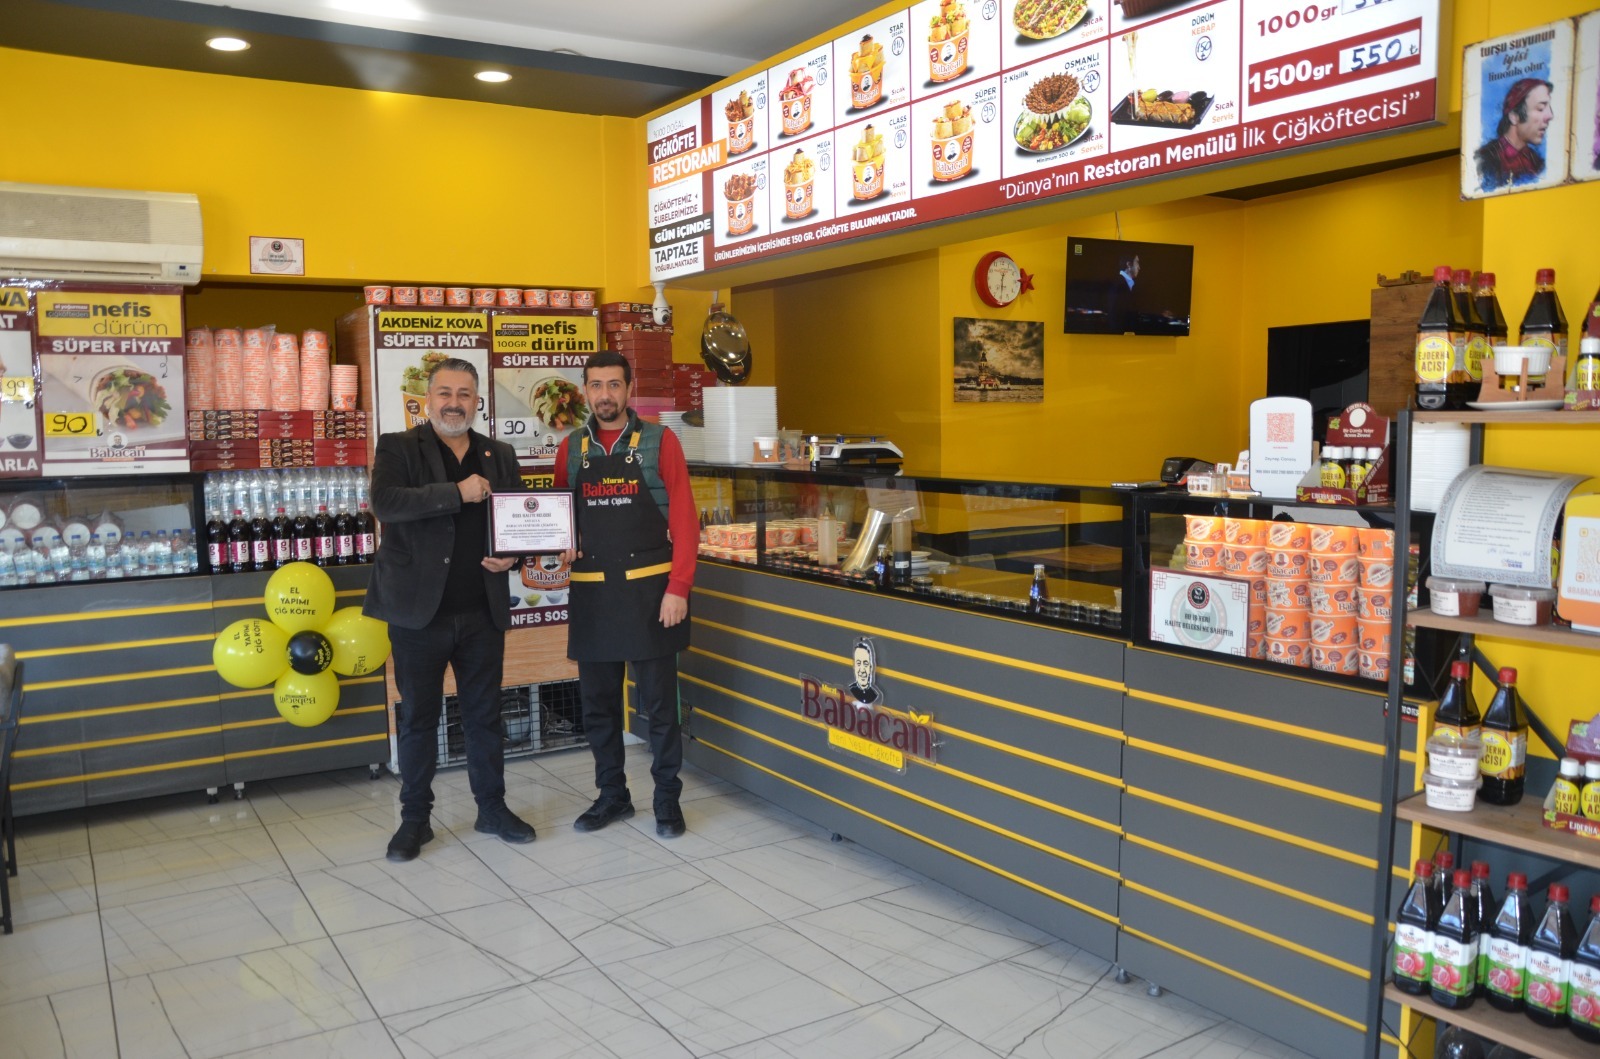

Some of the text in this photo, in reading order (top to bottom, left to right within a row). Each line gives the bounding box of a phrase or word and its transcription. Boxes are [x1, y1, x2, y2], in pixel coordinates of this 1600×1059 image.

[1083, 16, 1104, 27] Sıcak
[1191, 13, 1215, 27] DÜRÜM
[889, 22, 904, 34] STAR
[1081, 27, 1104, 38] Servis
[1191, 23, 1216, 37] KEBAP
[1480, 29, 1556, 58] turşu suyunun
[807, 55, 827, 67] MASTER
[1064, 53, 1100, 70] OSMANLI
[1351, 38, 1402, 72] 550
[1502, 49, 1530, 68] iyisi
[1524, 61, 1545, 75] olur
[1249, 59, 1333, 93] 1500gr
[891, 87, 906, 96] Sıcak
[974, 87, 996, 100] SÜPER
[1215, 100, 1234, 111] Sıcak
[889, 115, 907, 127] CLASS
[1212, 112, 1234, 124] Servis
[666, 120, 686, 134] DOĞAL
[817, 141, 831, 149] MEGA
[1083, 133, 1104, 143] Sıcak
[653, 131, 695, 162] ÇİĞKÖFTE
[1080, 143, 1104, 154] Servis
[1084, 153, 1161, 182] Restoran
[1166, 133, 1237, 165] Menülü
[1243, 126, 1266, 149] İlk
[653, 144, 720, 184] RESTORANI
[892, 181, 906, 190] Sıcak
[891, 190, 907, 199] Servis
[653, 194, 692, 213] ÇİĞKÖFTEMİZ
[654, 204, 698, 225] ŞUBELERİMİZDE
[655, 227, 676, 244] GÜN
[714, 208, 917, 262] ÜRÜNLERİMİZİN İÇERİSİNDE 150 GR. ÇİĞKÖFTE BULUNMAKTADIR.
[655, 241, 699, 264] TAPTAZE
[92, 302, 151, 318] nefis
[93, 320, 168, 336] dürüm
[381, 316, 483, 329] AKDENİZ KOVA
[531, 321, 577, 335] nefis
[52, 338, 171, 353] SÜPER FİYAT
[383, 333, 479, 347] SÜPER FİYAT
[497, 340, 527, 348] 100GR
[531, 338, 594, 351] dürüm
[502, 354, 549, 366] SÜPER
[1418, 351, 1450, 360] EJDERHA
[1421, 361, 1447, 373] ACISI
[53, 414, 88, 433] 90
[503, 420, 526, 435] 90
[89, 446, 146, 458] Babacan
[582, 481, 639, 498] Babacan
[280, 598, 309, 606] YAPIMI
[275, 607, 288, 615] ÇİĞ
[1165, 619, 1181, 628] KALİTE
[1210, 626, 1234, 637] SAHİPTİR
[234, 632, 240, 640] EL
[802, 678, 931, 759] Babacan
